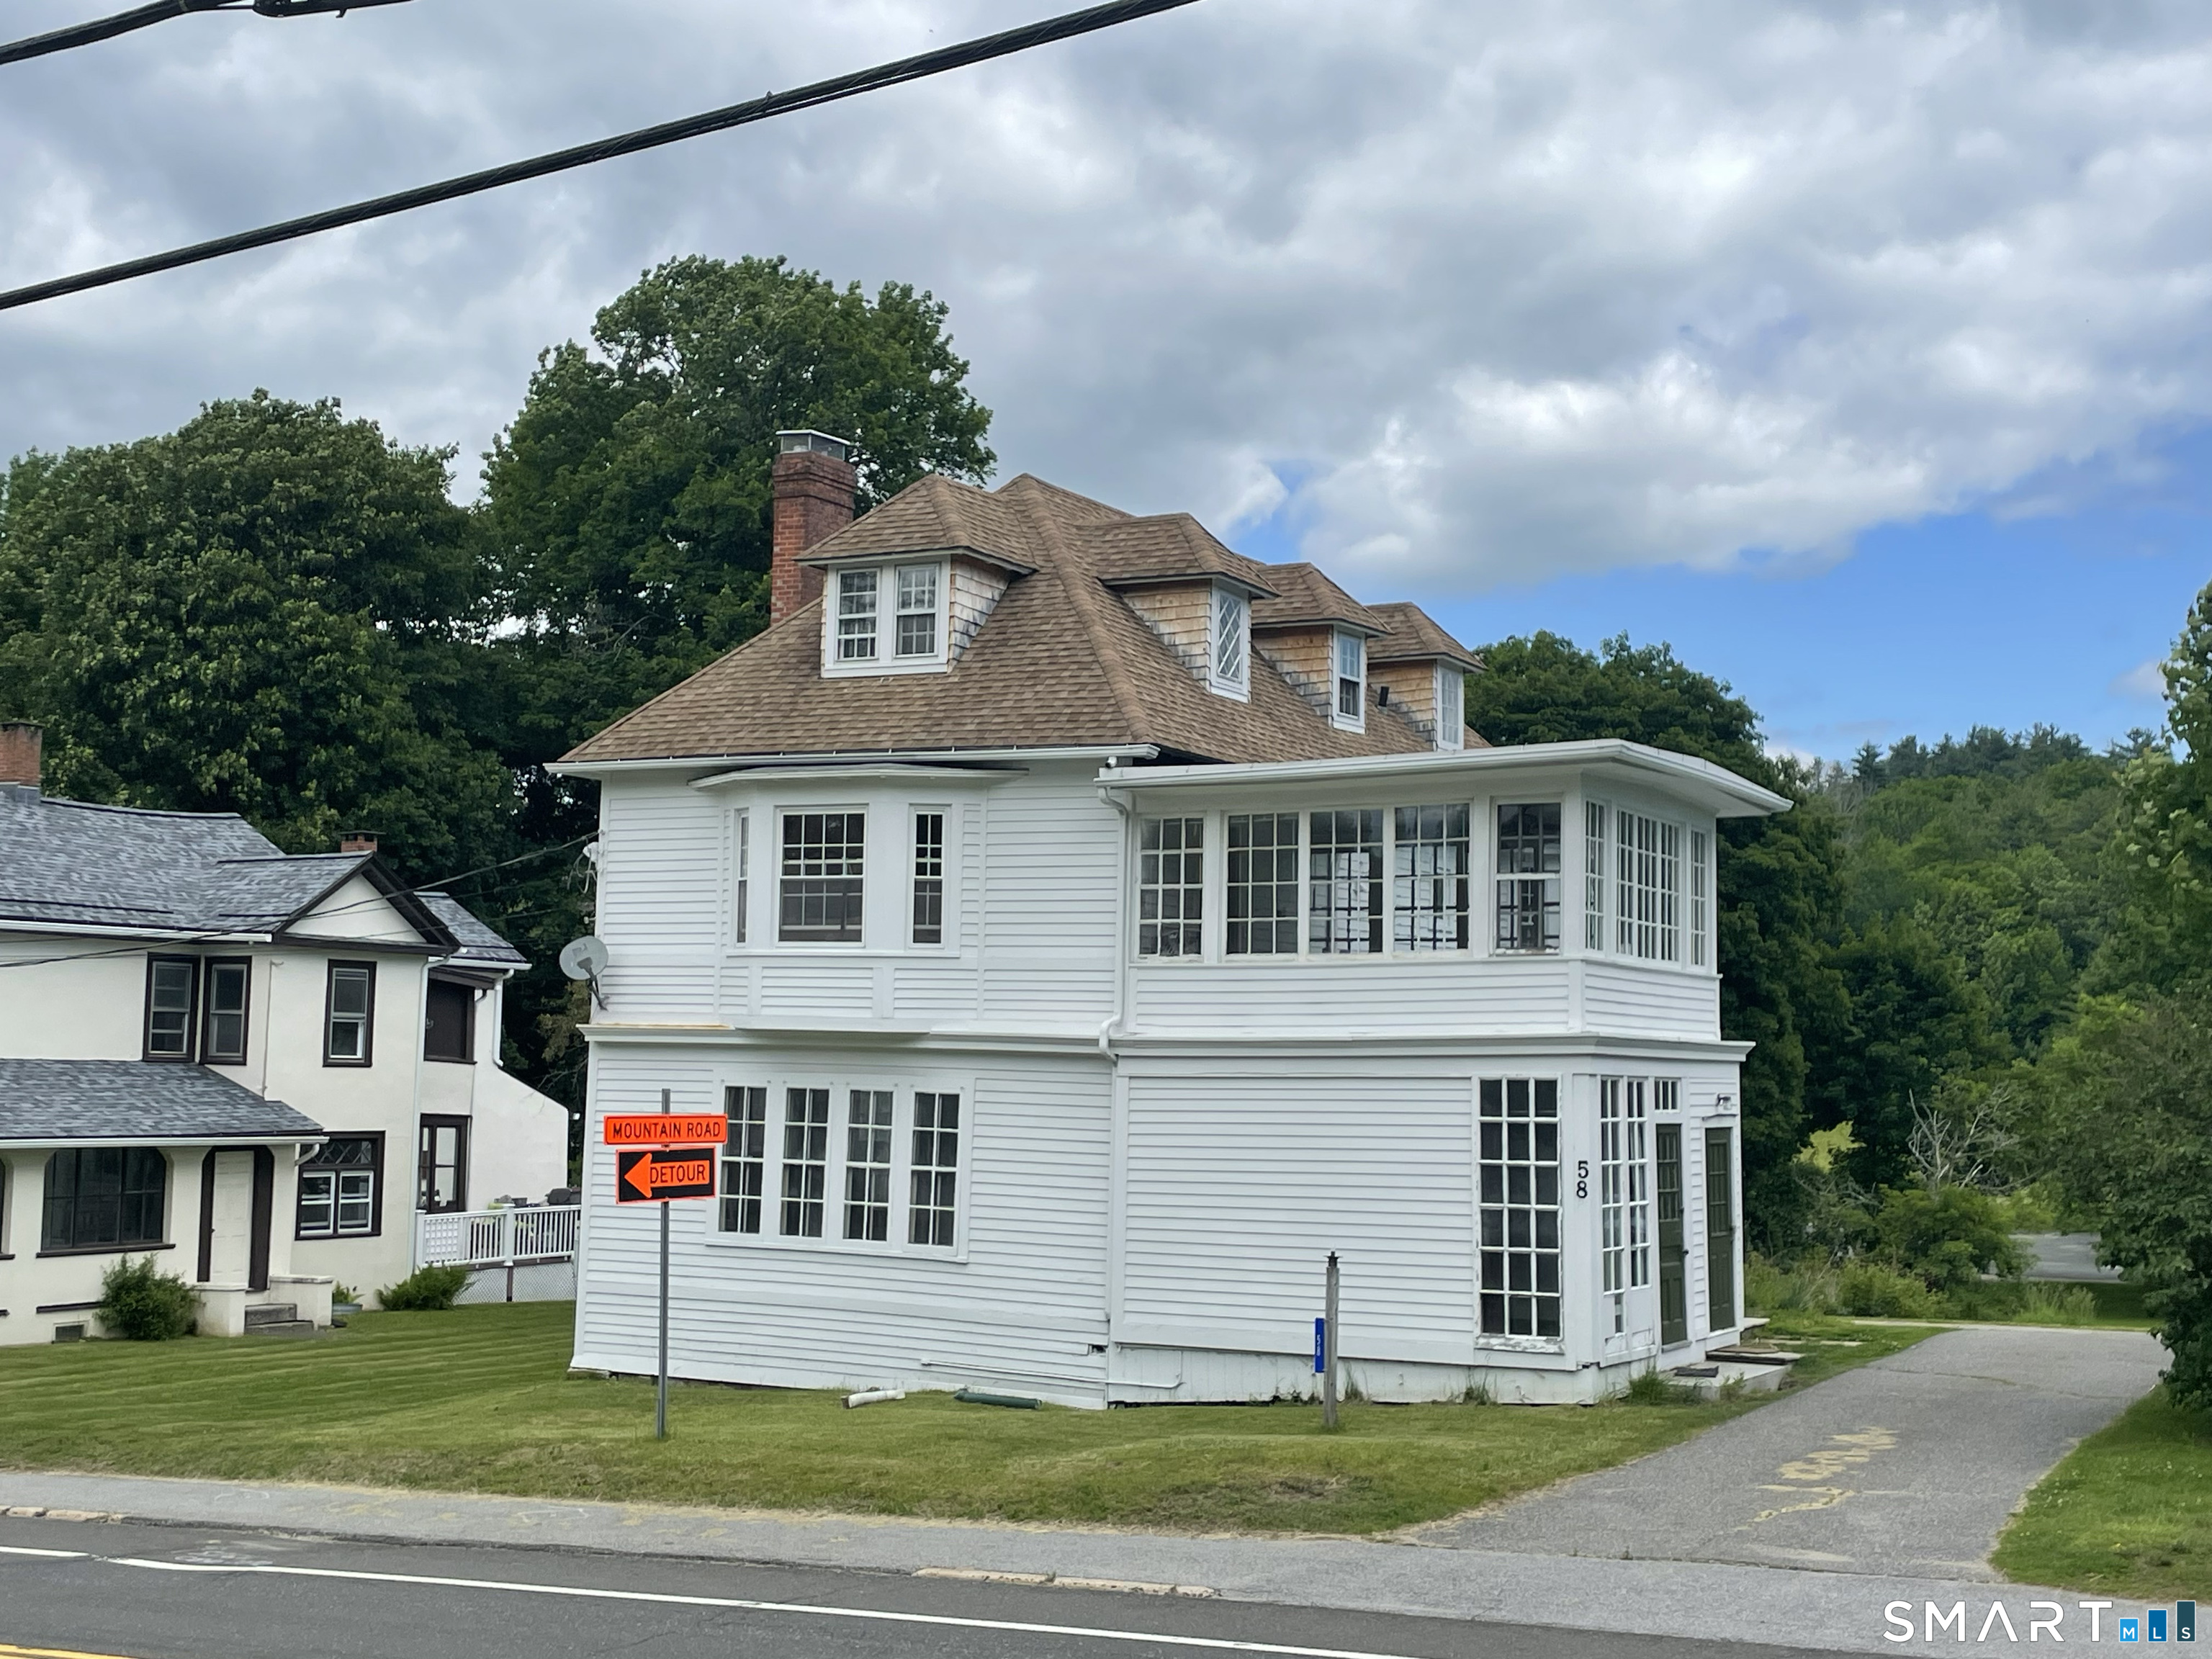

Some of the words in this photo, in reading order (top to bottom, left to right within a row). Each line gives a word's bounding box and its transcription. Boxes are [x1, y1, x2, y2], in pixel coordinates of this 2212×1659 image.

[613, 1122, 681, 1139] MOUNTAIN
[686, 1122, 720, 1138] ROAD
[649, 1164, 706, 1183] DETOUR
[1576, 1160, 1588, 1198] 58
